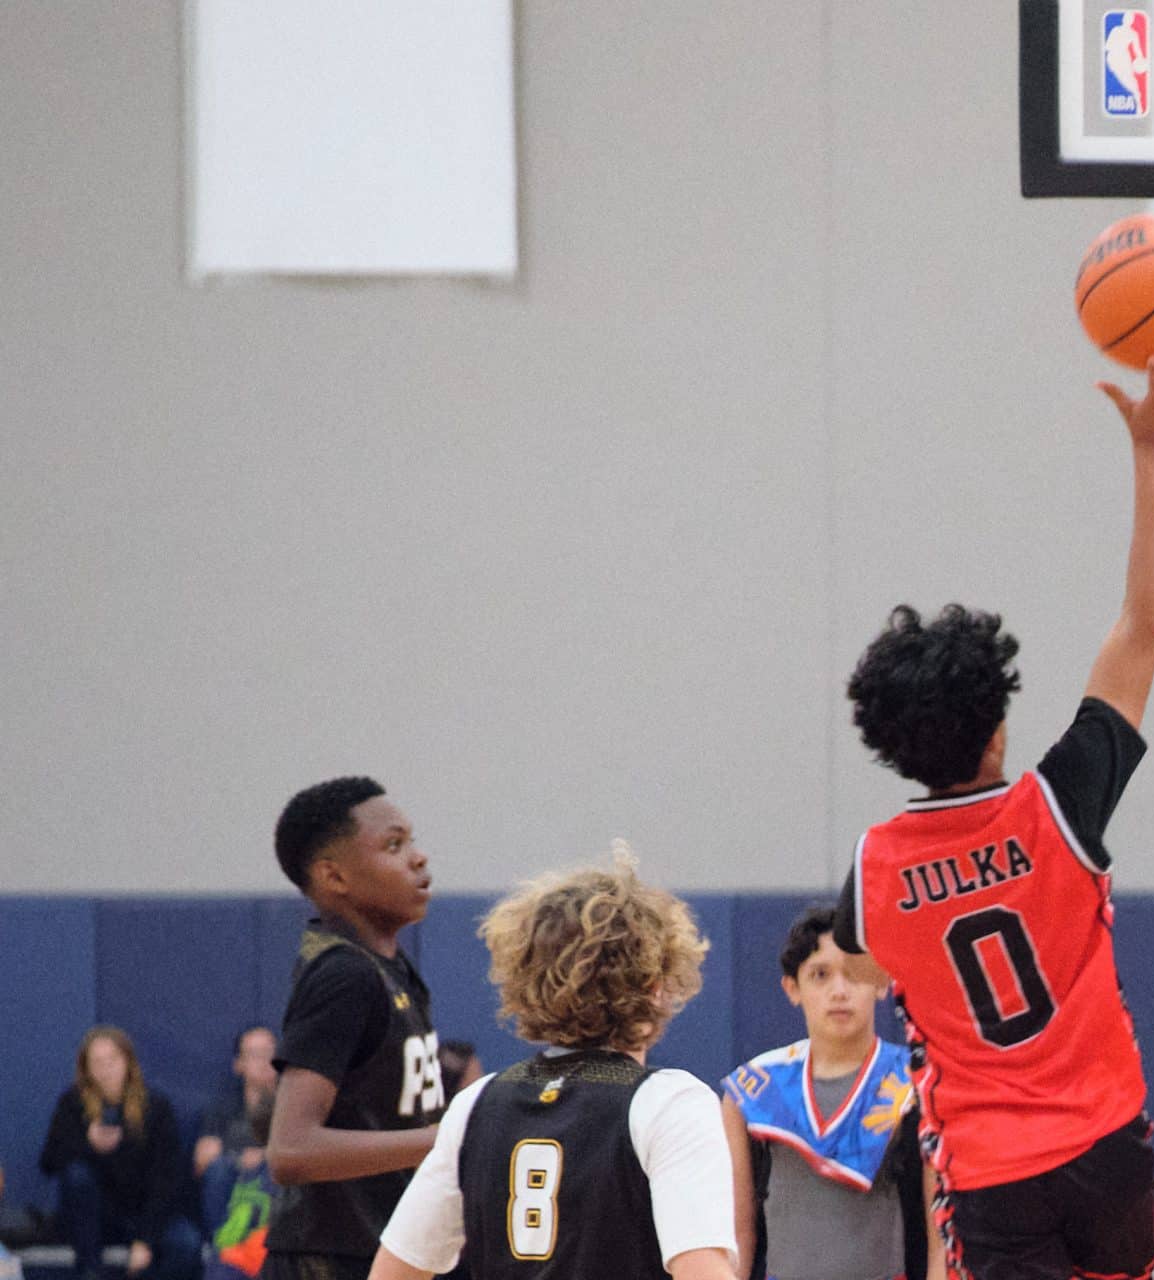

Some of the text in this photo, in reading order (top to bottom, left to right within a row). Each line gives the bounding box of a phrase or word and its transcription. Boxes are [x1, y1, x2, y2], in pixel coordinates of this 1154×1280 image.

[1108, 95, 1135, 111] NBA
[897, 835, 1034, 911] JULKA
[942, 904, 1060, 1051] 0
[507, 1138, 564, 1262] 8
